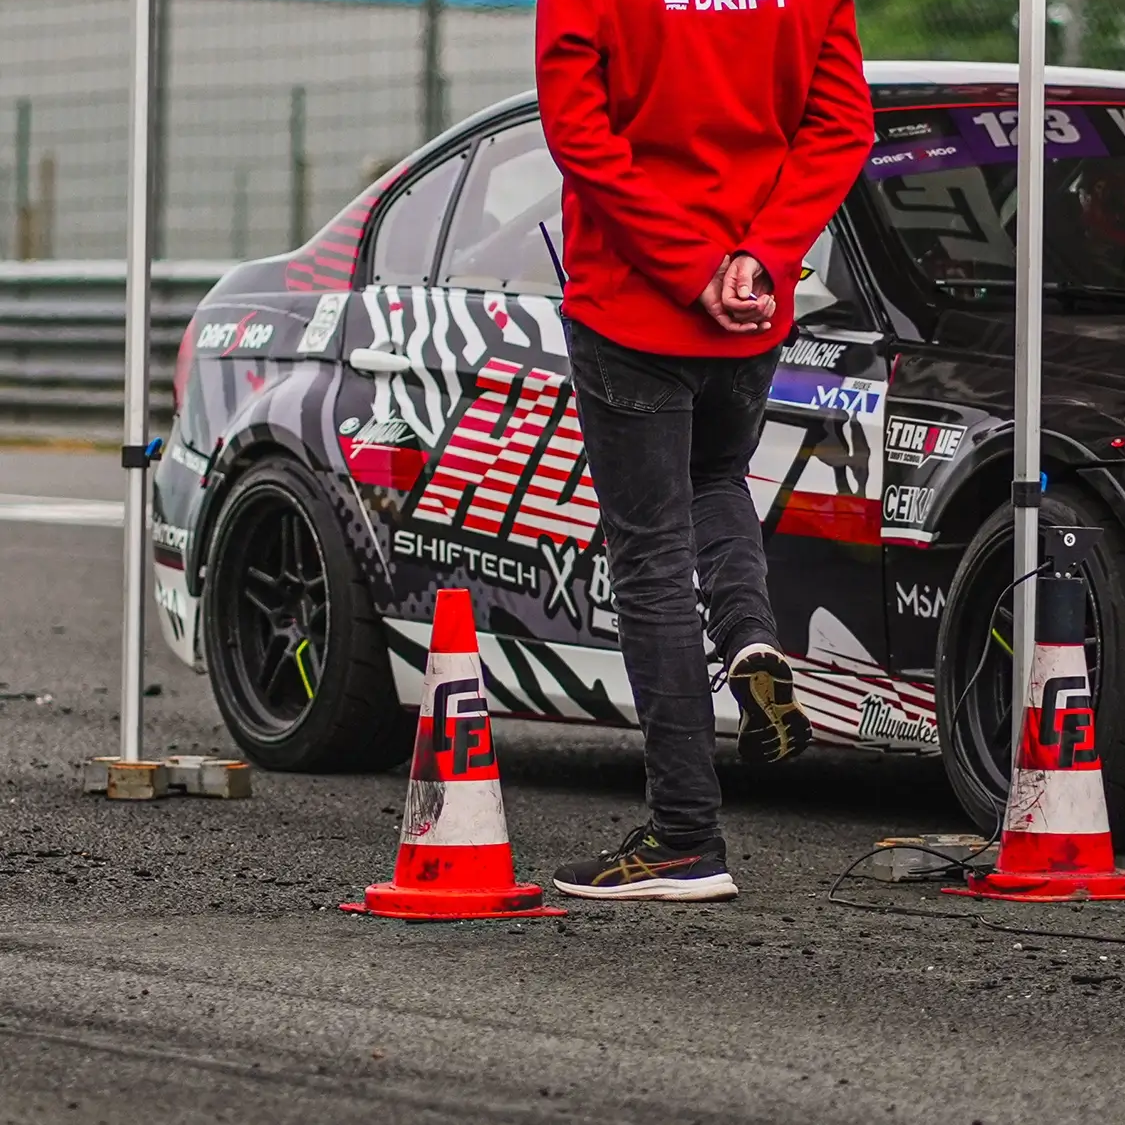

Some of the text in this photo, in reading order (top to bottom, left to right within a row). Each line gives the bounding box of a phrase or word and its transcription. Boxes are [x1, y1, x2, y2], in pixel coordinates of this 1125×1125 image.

[889, 421, 962, 455] TORQUE
[393, 530, 537, 589] SHIFTECH
[859, 694, 938, 744] Milwaukee
